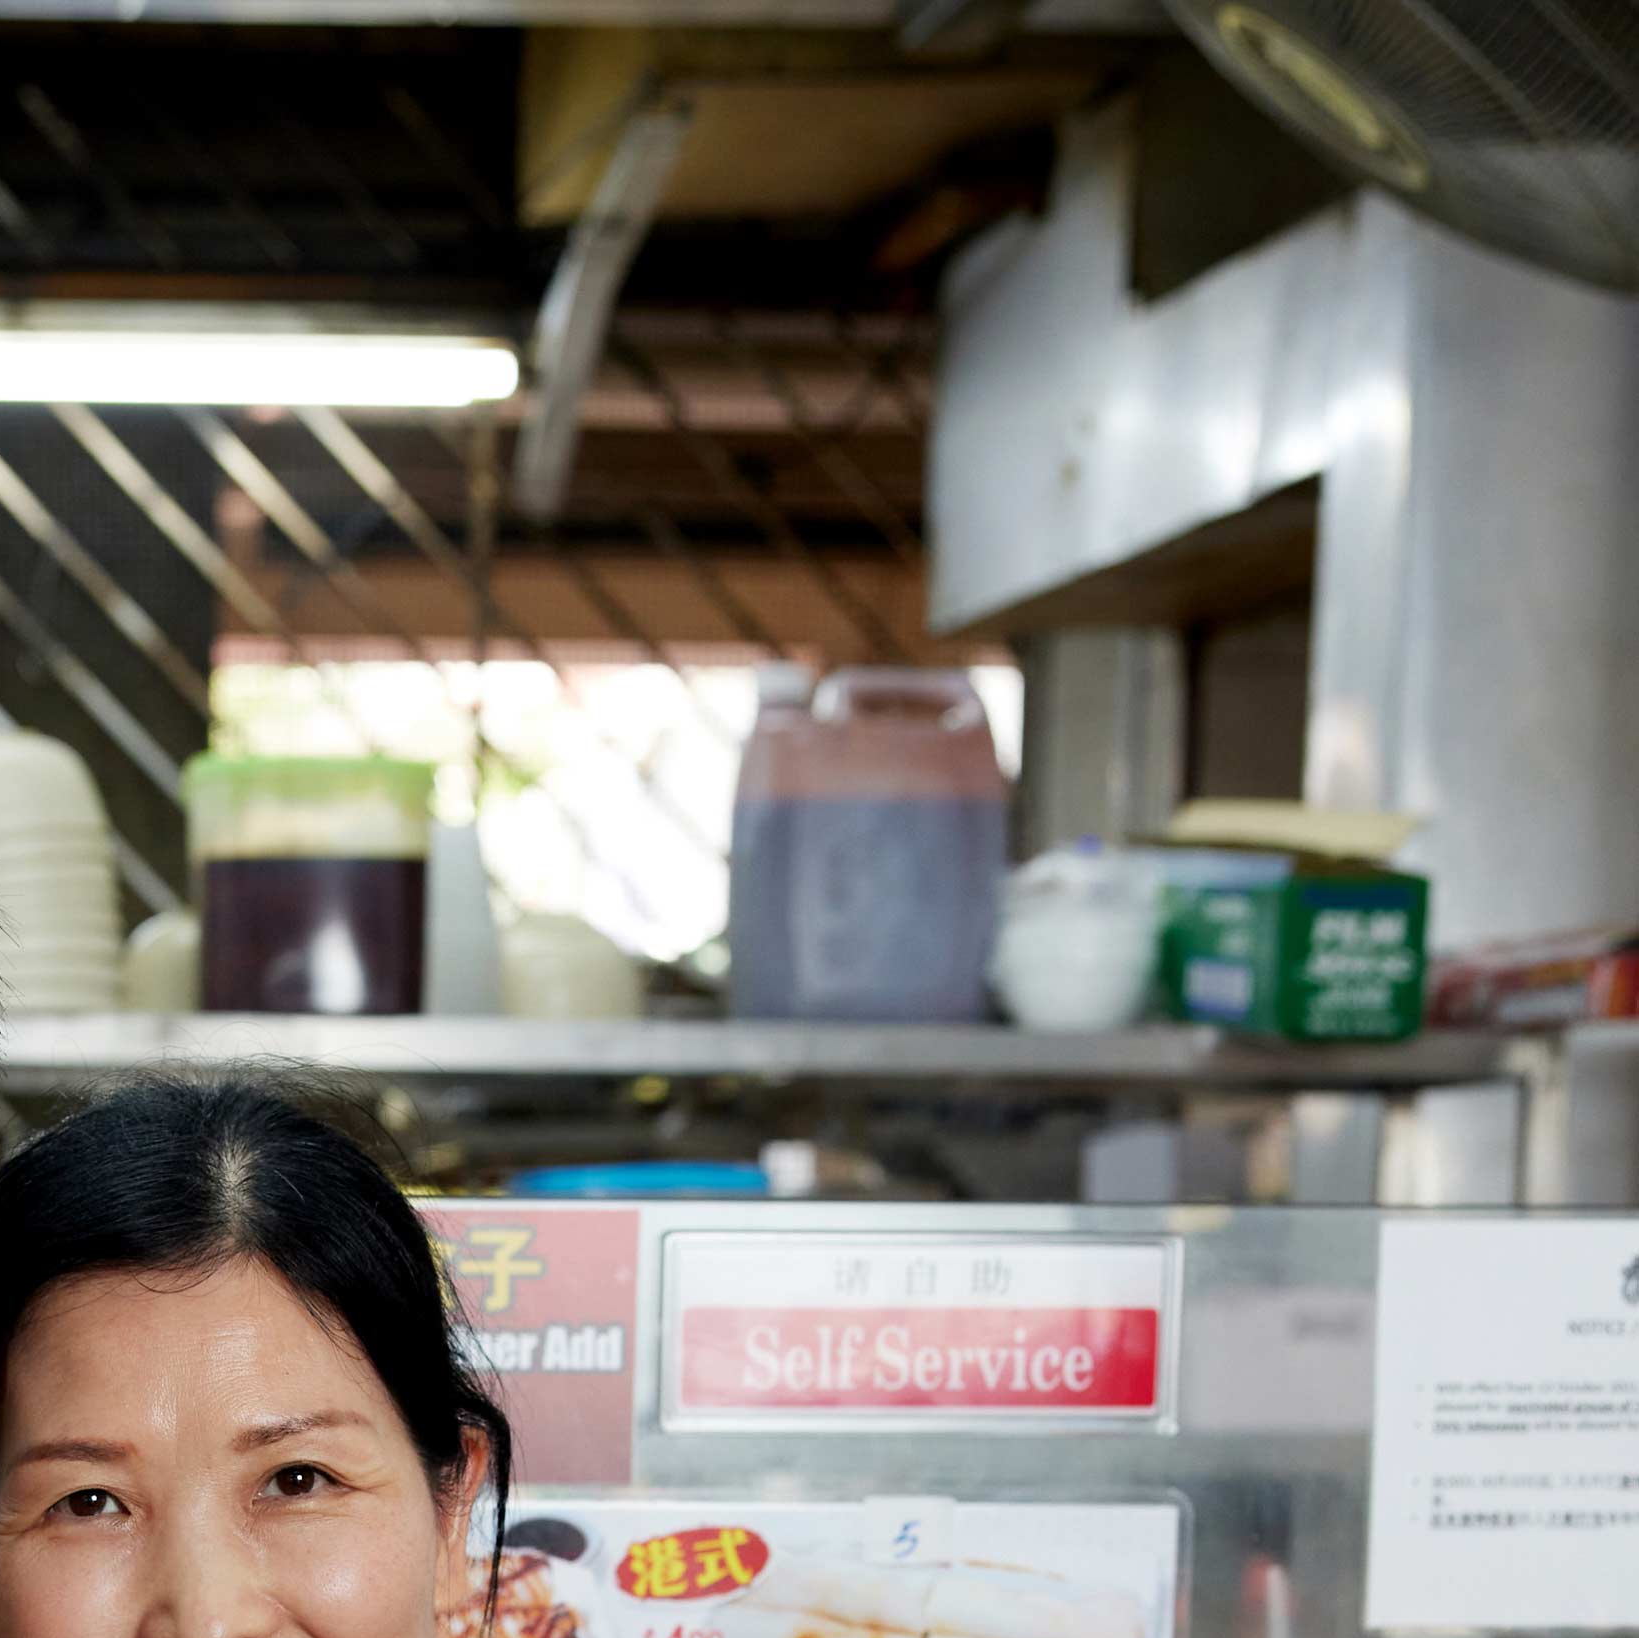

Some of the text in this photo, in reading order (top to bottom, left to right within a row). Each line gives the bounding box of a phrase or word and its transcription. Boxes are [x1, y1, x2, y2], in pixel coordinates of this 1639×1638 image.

[541, 1324, 622, 1371] Add
[741, 1324, 1095, 1394] Self Service
[628, 1527, 753, 1598] 港式
[890, 1519, 921, 1560] 5
